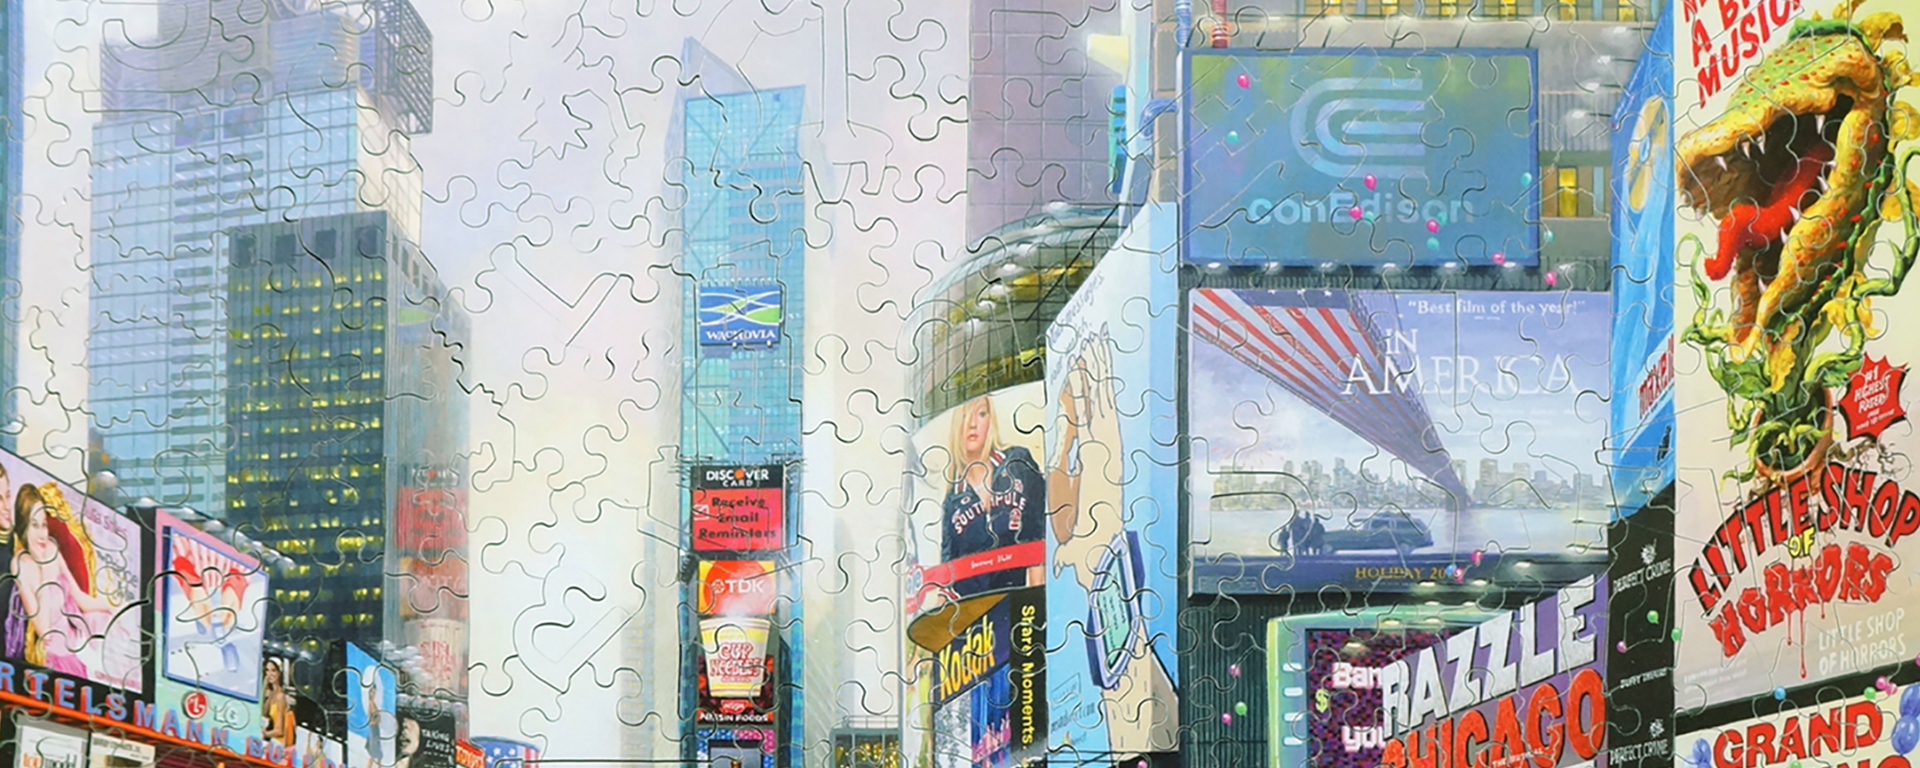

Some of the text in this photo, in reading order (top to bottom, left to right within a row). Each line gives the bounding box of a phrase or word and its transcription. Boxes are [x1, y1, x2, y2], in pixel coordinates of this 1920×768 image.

[1692, 19, 1712, 67] A
[1697, 0, 1800, 109] MUSIC
[1249, 192, 1475, 225] conEdison
[1457, 299, 1486, 314] film
[1490, 299, 1506, 314] of
[1511, 300, 1535, 314] the
[706, 329, 777, 341] WACHOVIA
[1385, 328, 1418, 354] IN
[1341, 354, 1580, 395] AMERICA
[706, 468, 770, 481] DISCOVER
[722, 480, 754, 488] CARD
[711, 496, 766, 507] Receive
[718, 512, 760, 523] Email
[699, 528, 777, 539] Reminders
[1688, 461, 1920, 618] LITTLE SHOP
[1788, 526, 1816, 558] OF
[725, 580, 764, 593] TDK
[1355, 566, 1425, 579] HOLIDAY
[1708, 541, 1894, 660] HORRORS
[1022, 604, 1036, 657] Share
[1819, 607, 1905, 652] LITTLE SHOP
[938, 615, 996, 701] Kodak
[1381, 573, 1595, 739] RAZZLE
[1819, 632, 1907, 677] OF HORRORS
[735, 712, 769, 722] FOODS
[420, 728, 450, 742] TAKING
[1713, 700, 1884, 768] GRAND
